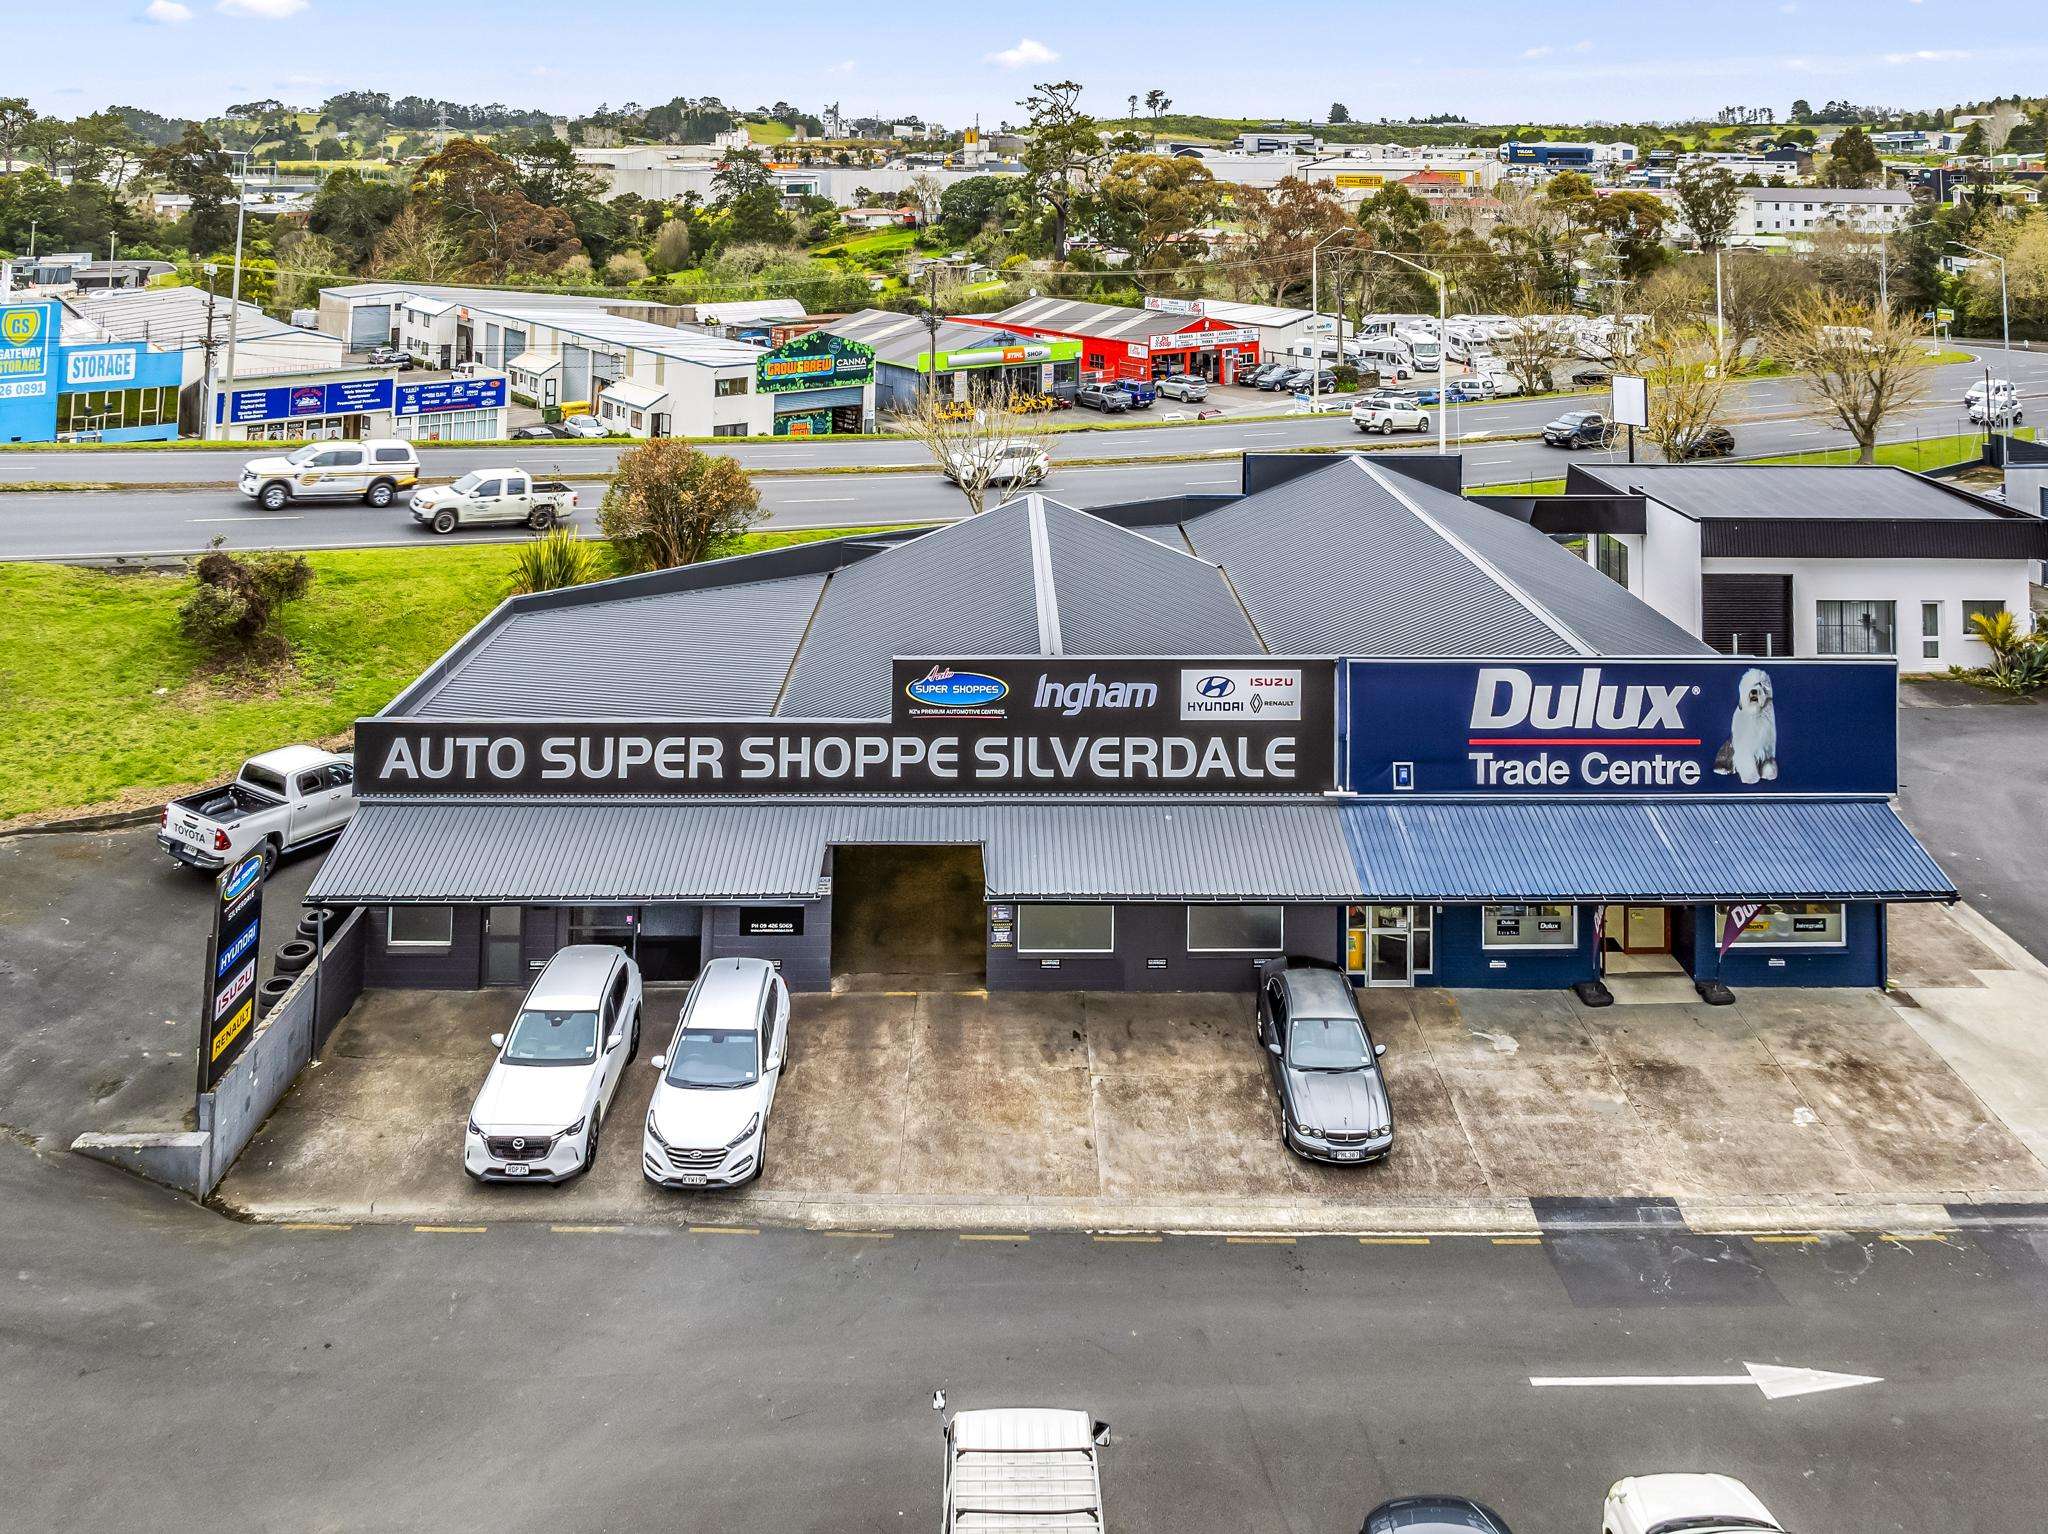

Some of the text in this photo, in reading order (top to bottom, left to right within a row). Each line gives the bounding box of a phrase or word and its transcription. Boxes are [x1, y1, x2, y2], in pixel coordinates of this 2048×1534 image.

[12, 318, 30, 334] GS
[836, 357, 866, 366] CANNA
[1006, 351, 1024, 359] STIHL
[1027, 350, 1043, 358] SHOP
[72, 354, 131, 379] STORAGE
[16, 383, 44, 395] 0891
[915, 685, 999, 694] SUPER SHOPPES
[1250, 678, 1294, 686] ISUZU
[1033, 673, 1158, 716] Ingham
[1188, 702, 1244, 712] HYUNDAI
[379, 737, 1295, 779] AUTO SUPER SHOPPE SILVERDALE
[1468, 752, 1701, 785] Trade Centre
[174, 823, 206, 843] TOYOTA
[220, 925, 256, 971] HYUNDAI
[218, 967, 253, 1013] ISUZU
[215, 1007, 250, 1050] RENAULT
